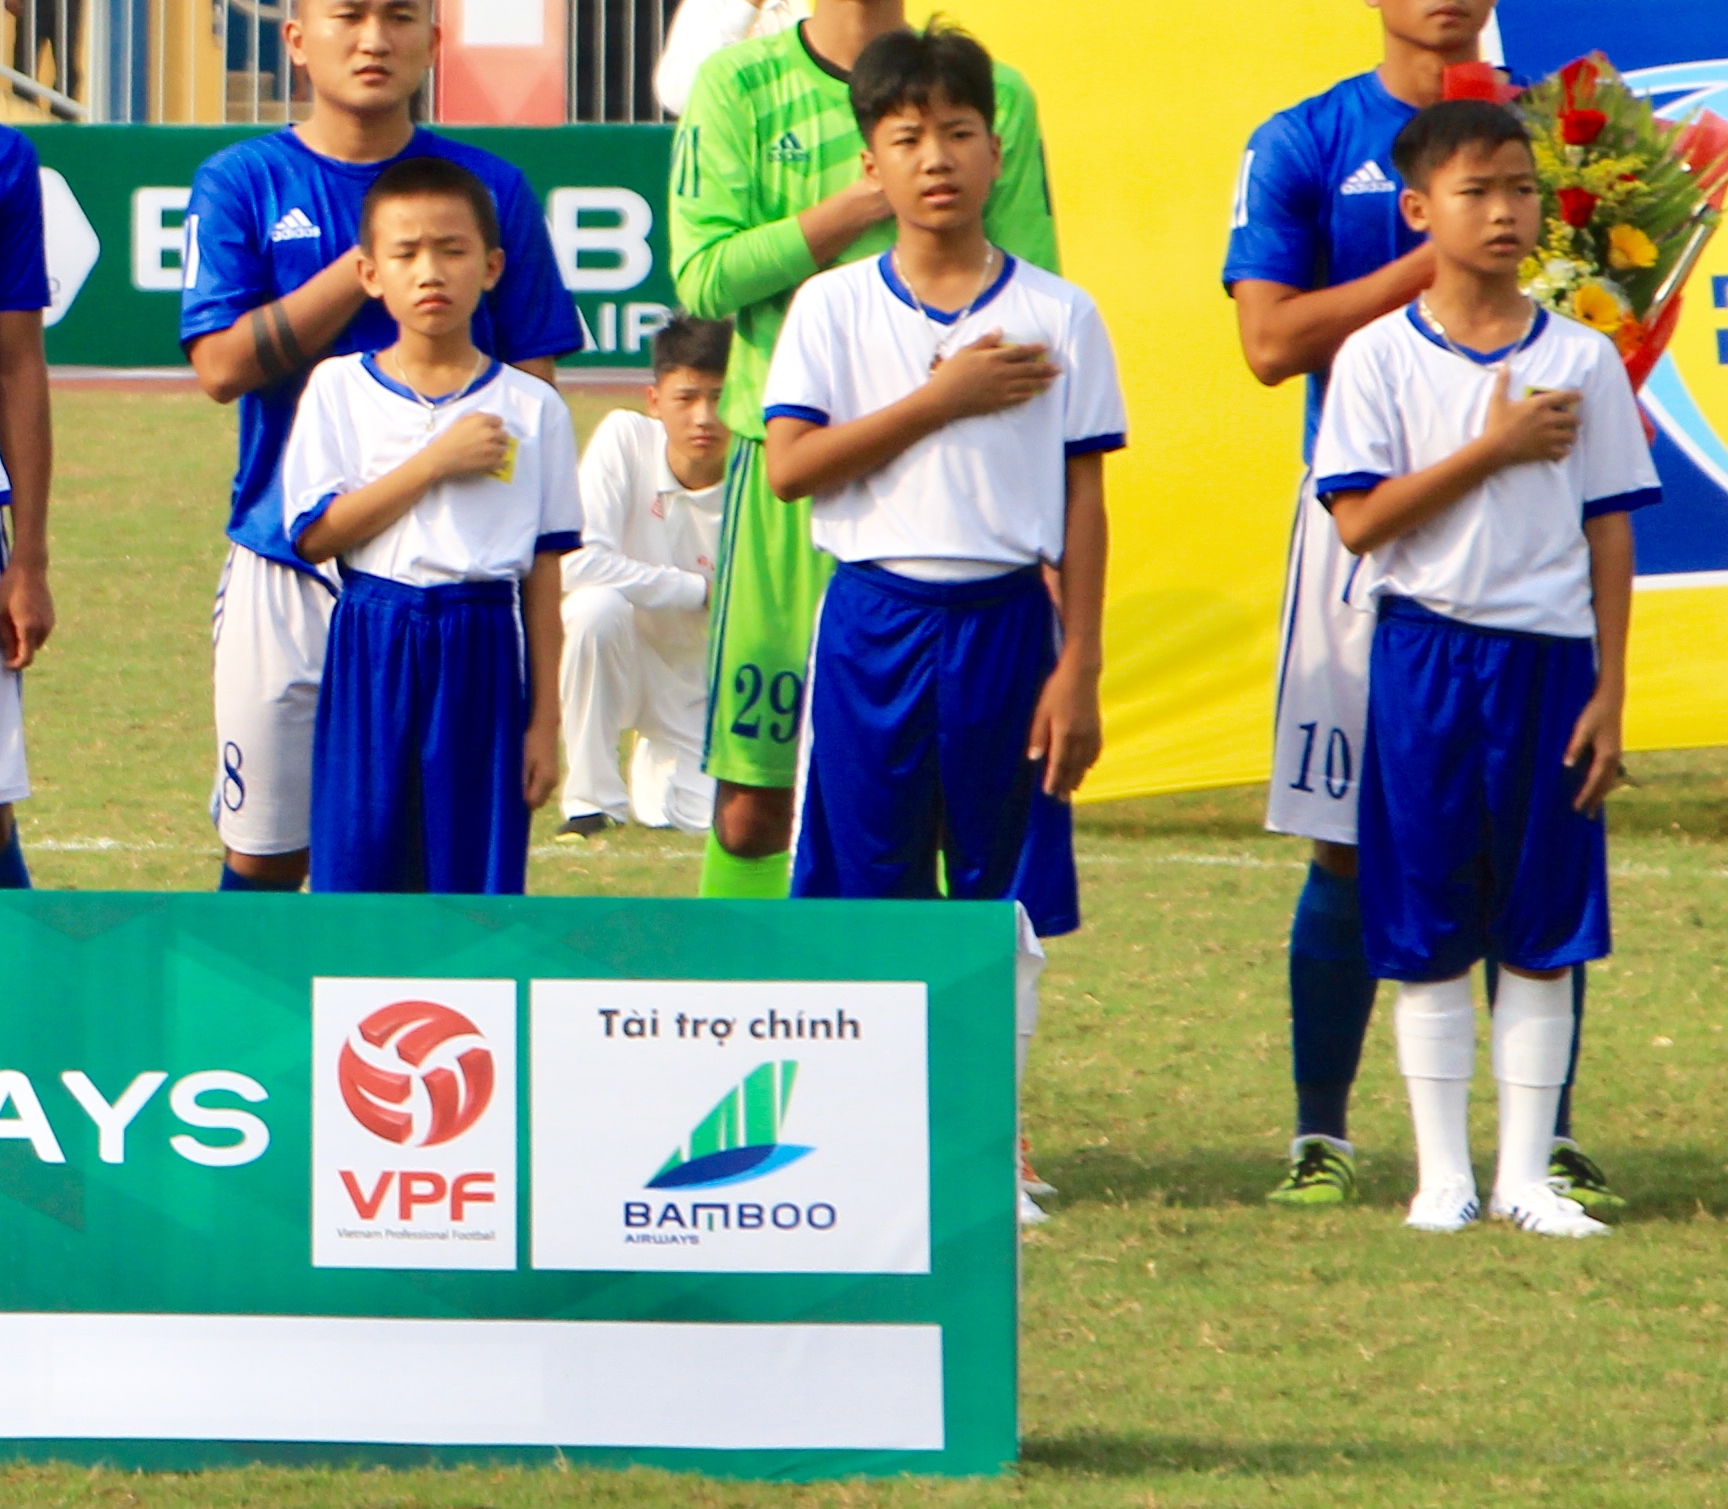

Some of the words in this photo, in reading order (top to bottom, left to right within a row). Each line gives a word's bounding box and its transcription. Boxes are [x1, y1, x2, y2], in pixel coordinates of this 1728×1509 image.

[730, 662, 803, 744] 29
[223, 739, 247, 812] 8
[1288, 720, 1352, 800] 10
[598, 1008, 660, 1039] Tài
[675, 1012, 737, 1047] trợ
[748, 1008, 861, 1040] chính
[337, 1170, 496, 1222] VPF
[623, 1201, 838, 1232] BAMBOO
